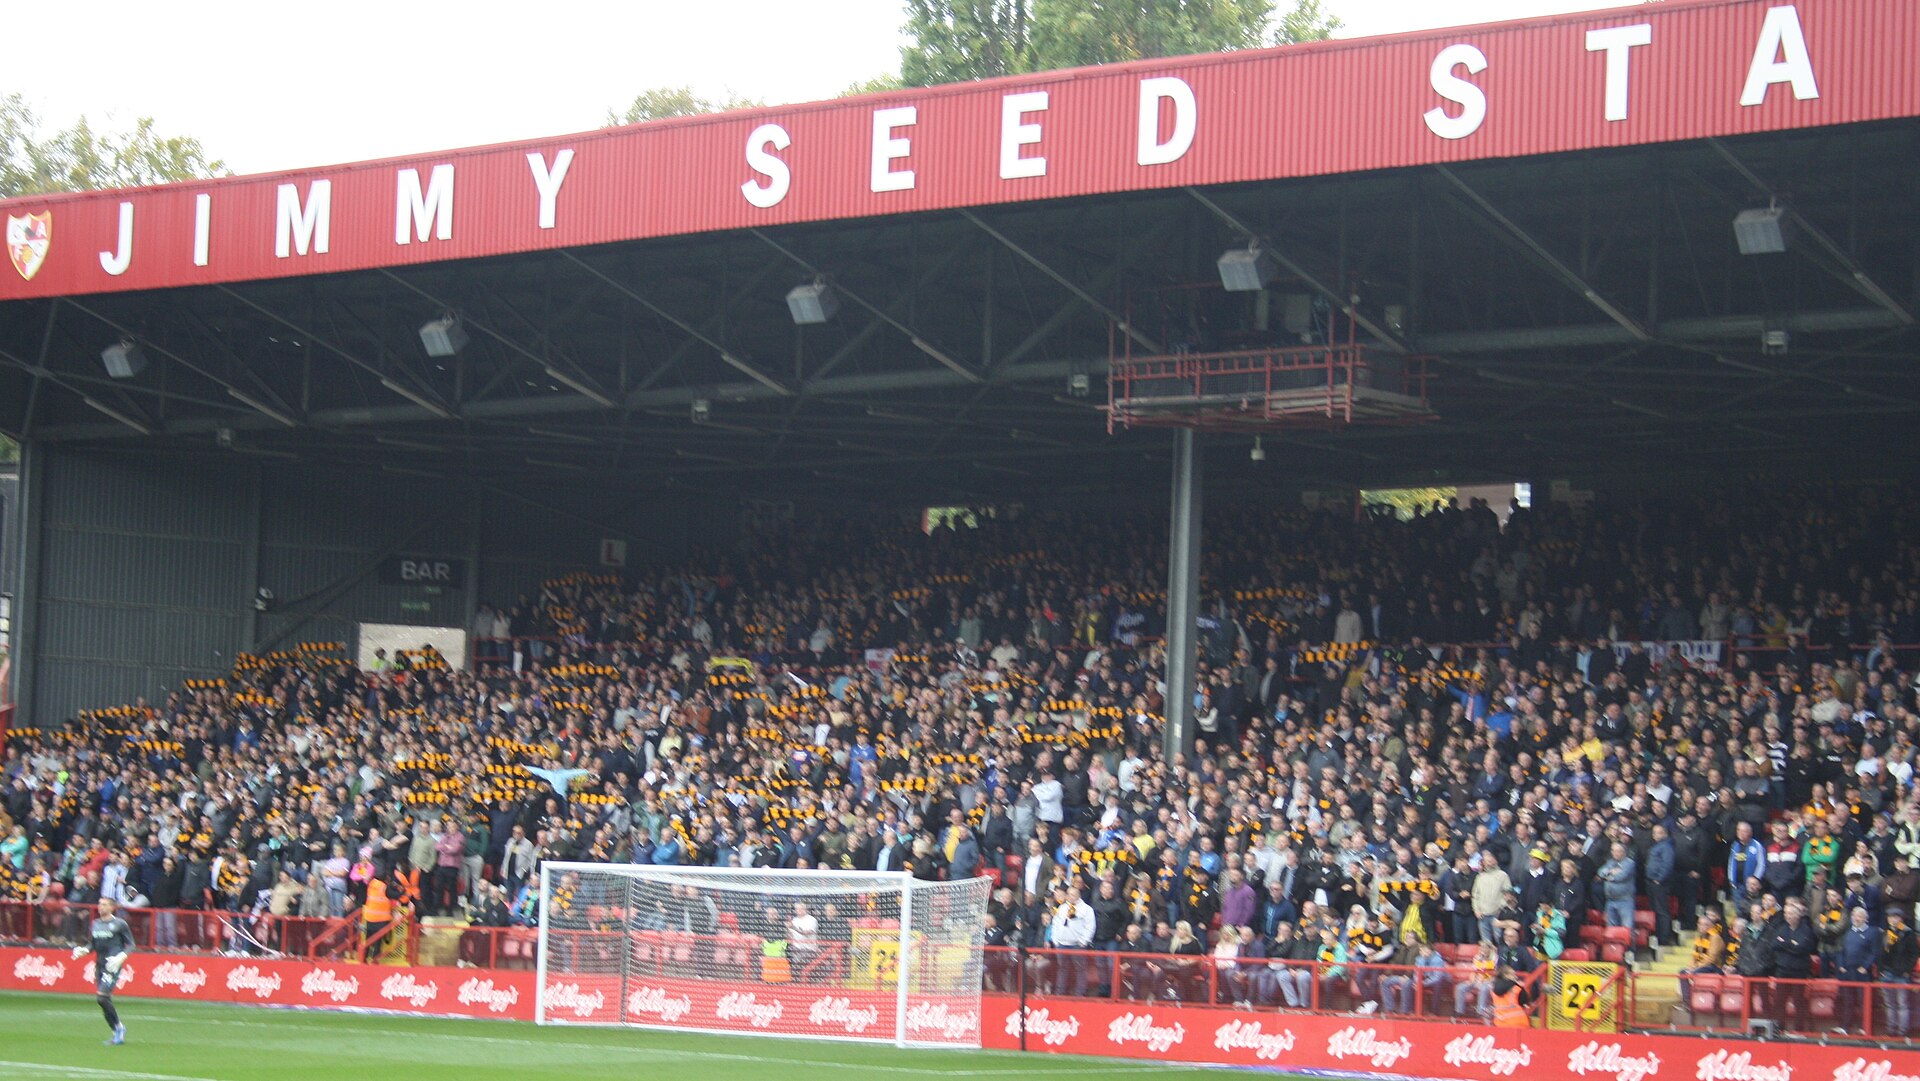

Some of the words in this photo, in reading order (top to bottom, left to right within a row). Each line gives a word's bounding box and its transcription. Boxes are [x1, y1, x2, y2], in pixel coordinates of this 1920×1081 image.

[100, 148, 575, 276] JIMMY
[741, 77, 1197, 209] SEED
[1423, 5, 1819, 139] STA
[401, 560, 450, 581] BAR
[14, 954, 66, 986] Kellogg's
[152, 960, 207, 993] Kellogg's
[226, 965, 282, 998] Kellogg's
[301, 968, 360, 1002] Kellogg's
[381, 973, 438, 1007] Kellogg's
[458, 977, 519, 1012] Kellogg's
[628, 986, 692, 1022] Kellogg's
[1568, 983, 1596, 1010] 22
[716, 991, 784, 1032] Kellogg's
[809, 995, 879, 1034] Kellogg's
[1005, 1006, 1081, 1045] Kellogg's
[1107, 1012, 1187, 1053] Kellogg's
[1214, 1019, 1297, 1060] Kellogg's
[1326, 1026, 1413, 1068] Kellogg's
[1443, 1033, 1534, 1075] Kellogg's
[1567, 1040, 1662, 1081] Kellogg's
